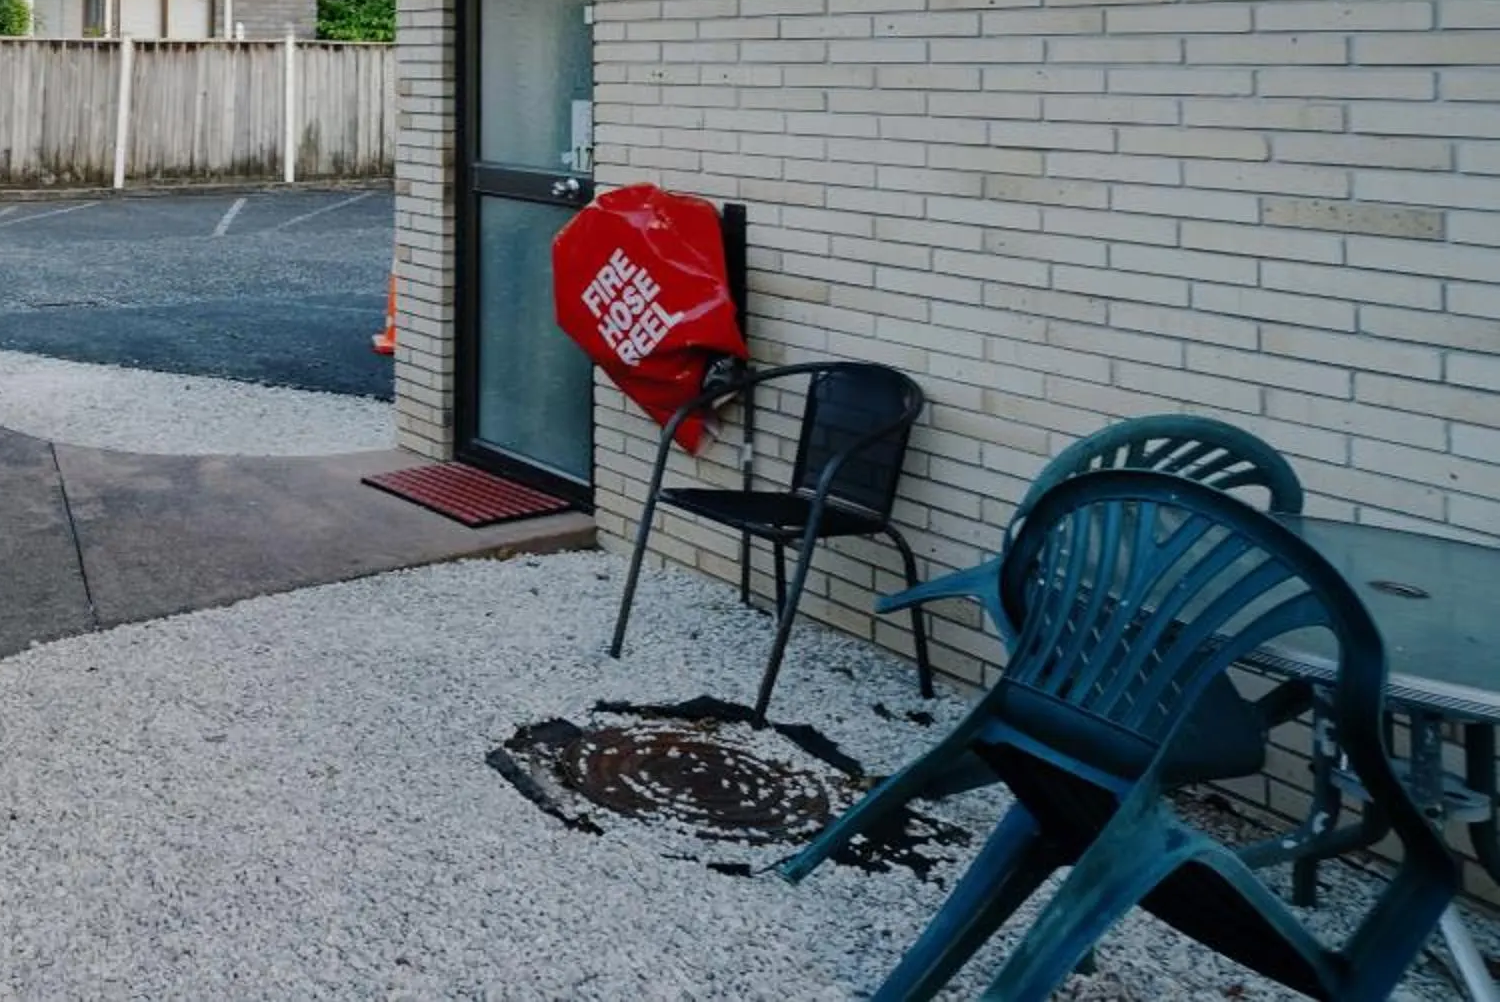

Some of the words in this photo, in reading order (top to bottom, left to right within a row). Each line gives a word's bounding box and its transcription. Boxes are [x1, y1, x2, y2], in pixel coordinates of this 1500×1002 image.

[581, 247, 638, 319] FIRE
[598, 268, 661, 349] HOSE
[616, 302, 685, 366] REEL
